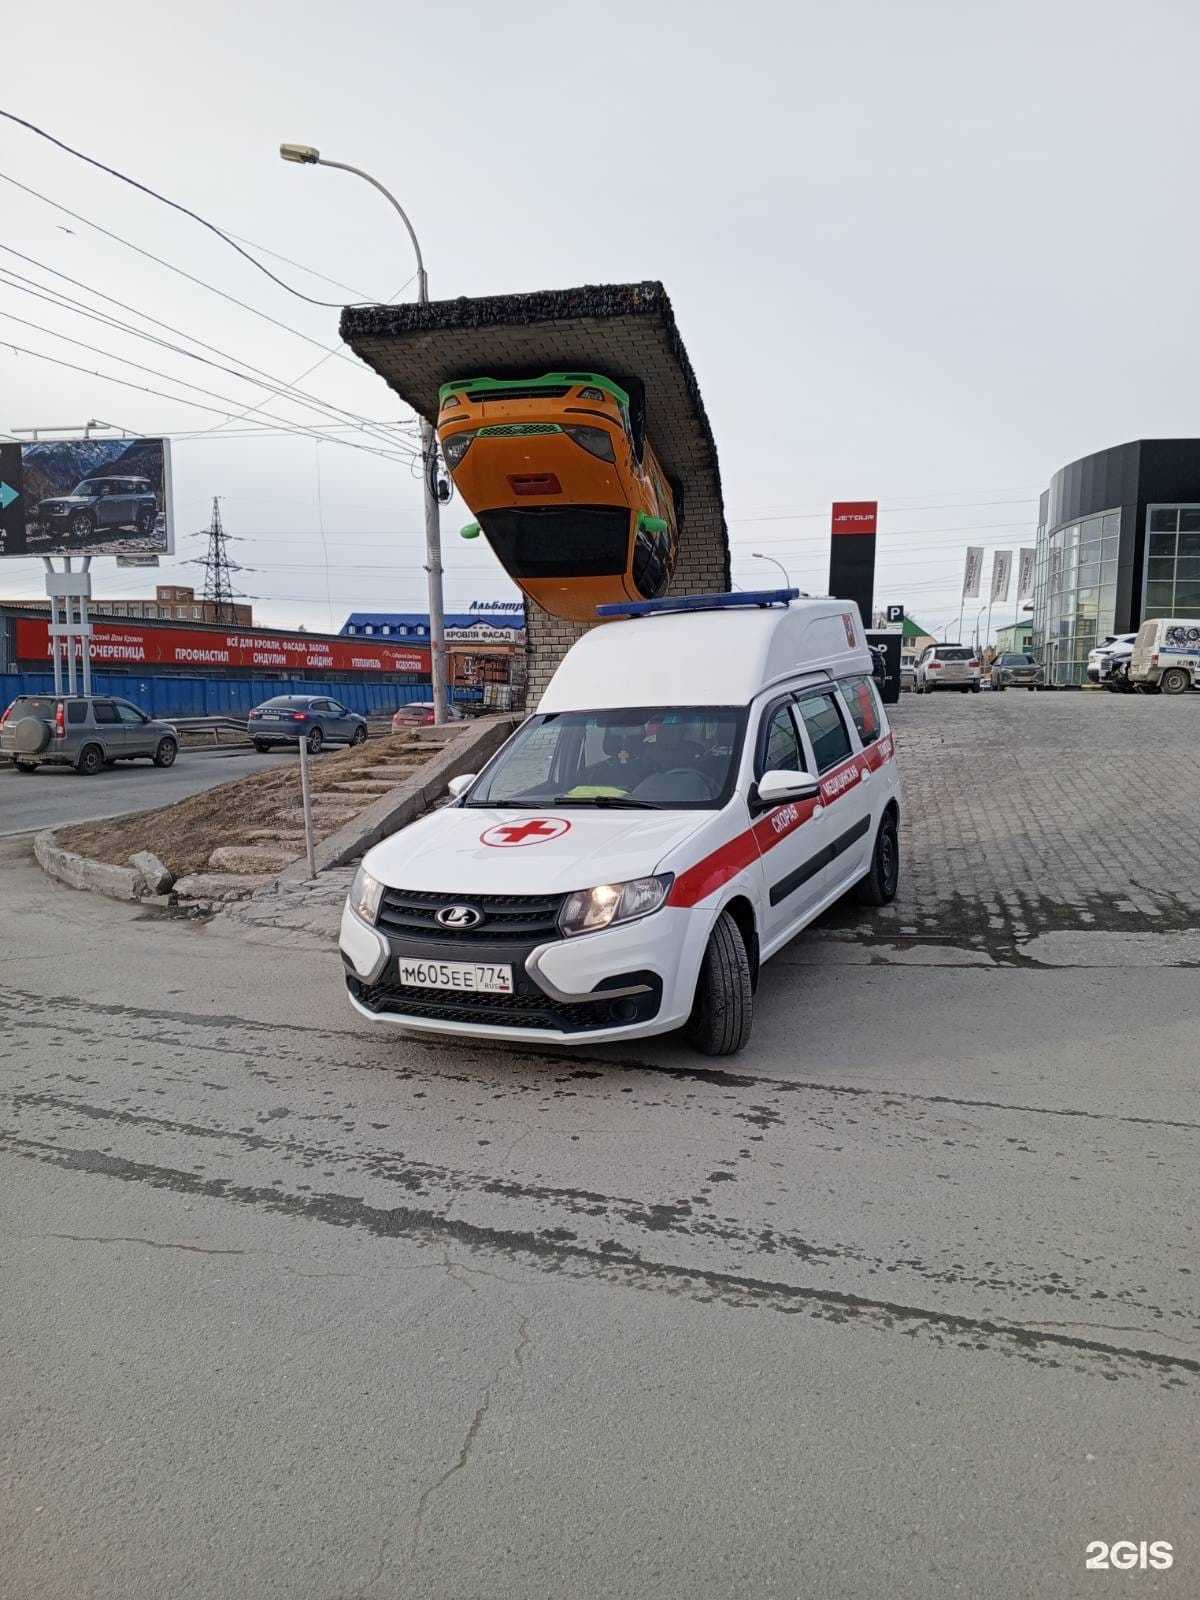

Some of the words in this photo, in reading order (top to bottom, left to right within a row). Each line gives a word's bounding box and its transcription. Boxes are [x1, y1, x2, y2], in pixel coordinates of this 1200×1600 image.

[890, 607, 901, 620] P
[446, 631, 479, 639] КРОВЛЯ
[481, 631, 511, 640] ФАСАД
[240, 638, 253, 649] ДЛЯ
[175, 647, 229, 662] ПРОФНАСТИЛ
[253, 652, 287, 665] ОНДУЛИН
[771, 803, 799, 833] СКОРАЯ
[476, 967, 506, 984] 774
